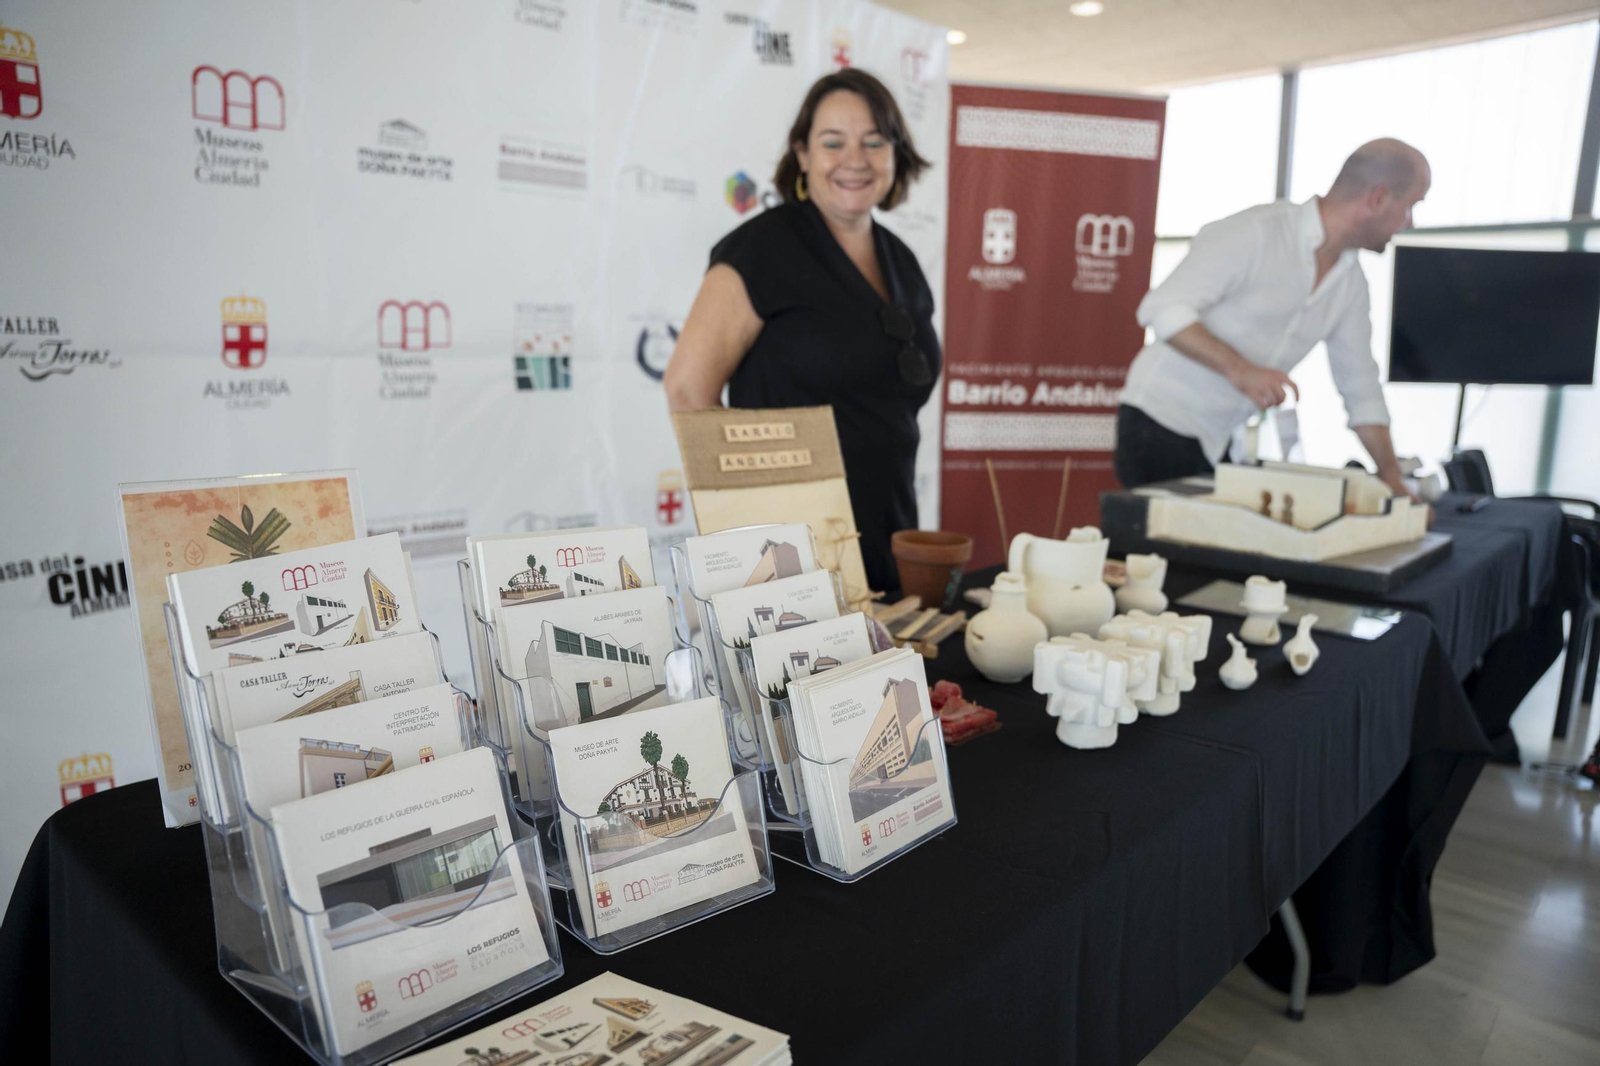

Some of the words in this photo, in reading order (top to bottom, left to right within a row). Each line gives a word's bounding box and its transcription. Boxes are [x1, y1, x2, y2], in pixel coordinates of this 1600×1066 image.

[948, 379, 1027, 406] Barrio
[728, 427, 793, 438] BARRIO
[319, 560, 345, 569] Museos
[321, 573, 346, 584] Ciudad
[240, 678, 260, 689] CASA
[260, 672, 288, 685] TALLER
[373, 683, 392, 693] CASA
[392, 677, 416, 689] TALLER
[393, 707, 420, 720] CENTRO
[420, 705, 430, 714] DE
[393, 721, 435, 736] PATRIMONIAL
[574, 743, 595, 753] MUSEO
[595, 740, 605, 748] DE
[605, 737, 619, 746] ARTE
[596, 746, 618, 757] PAKYTA
[320, 830, 336, 842] LOS
[336, 819, 374, 836] REFUGIOS
[374, 815, 385, 825] DE
[385, 812, 394, 821] LA
[395, 802, 424, 818] GUERRA
[424, 798, 441, 809] CIVIL
[441, 787, 475, 803] ESPAÑOLA
[706, 858, 724, 869] museo
[731, 852, 744, 860] arte
[706, 864, 724, 875] DOÑA
[723, 859, 745, 870] PAKYTA
[466, 943, 483, 956] LOS
[483, 927, 520, 949] REFUGIOS
